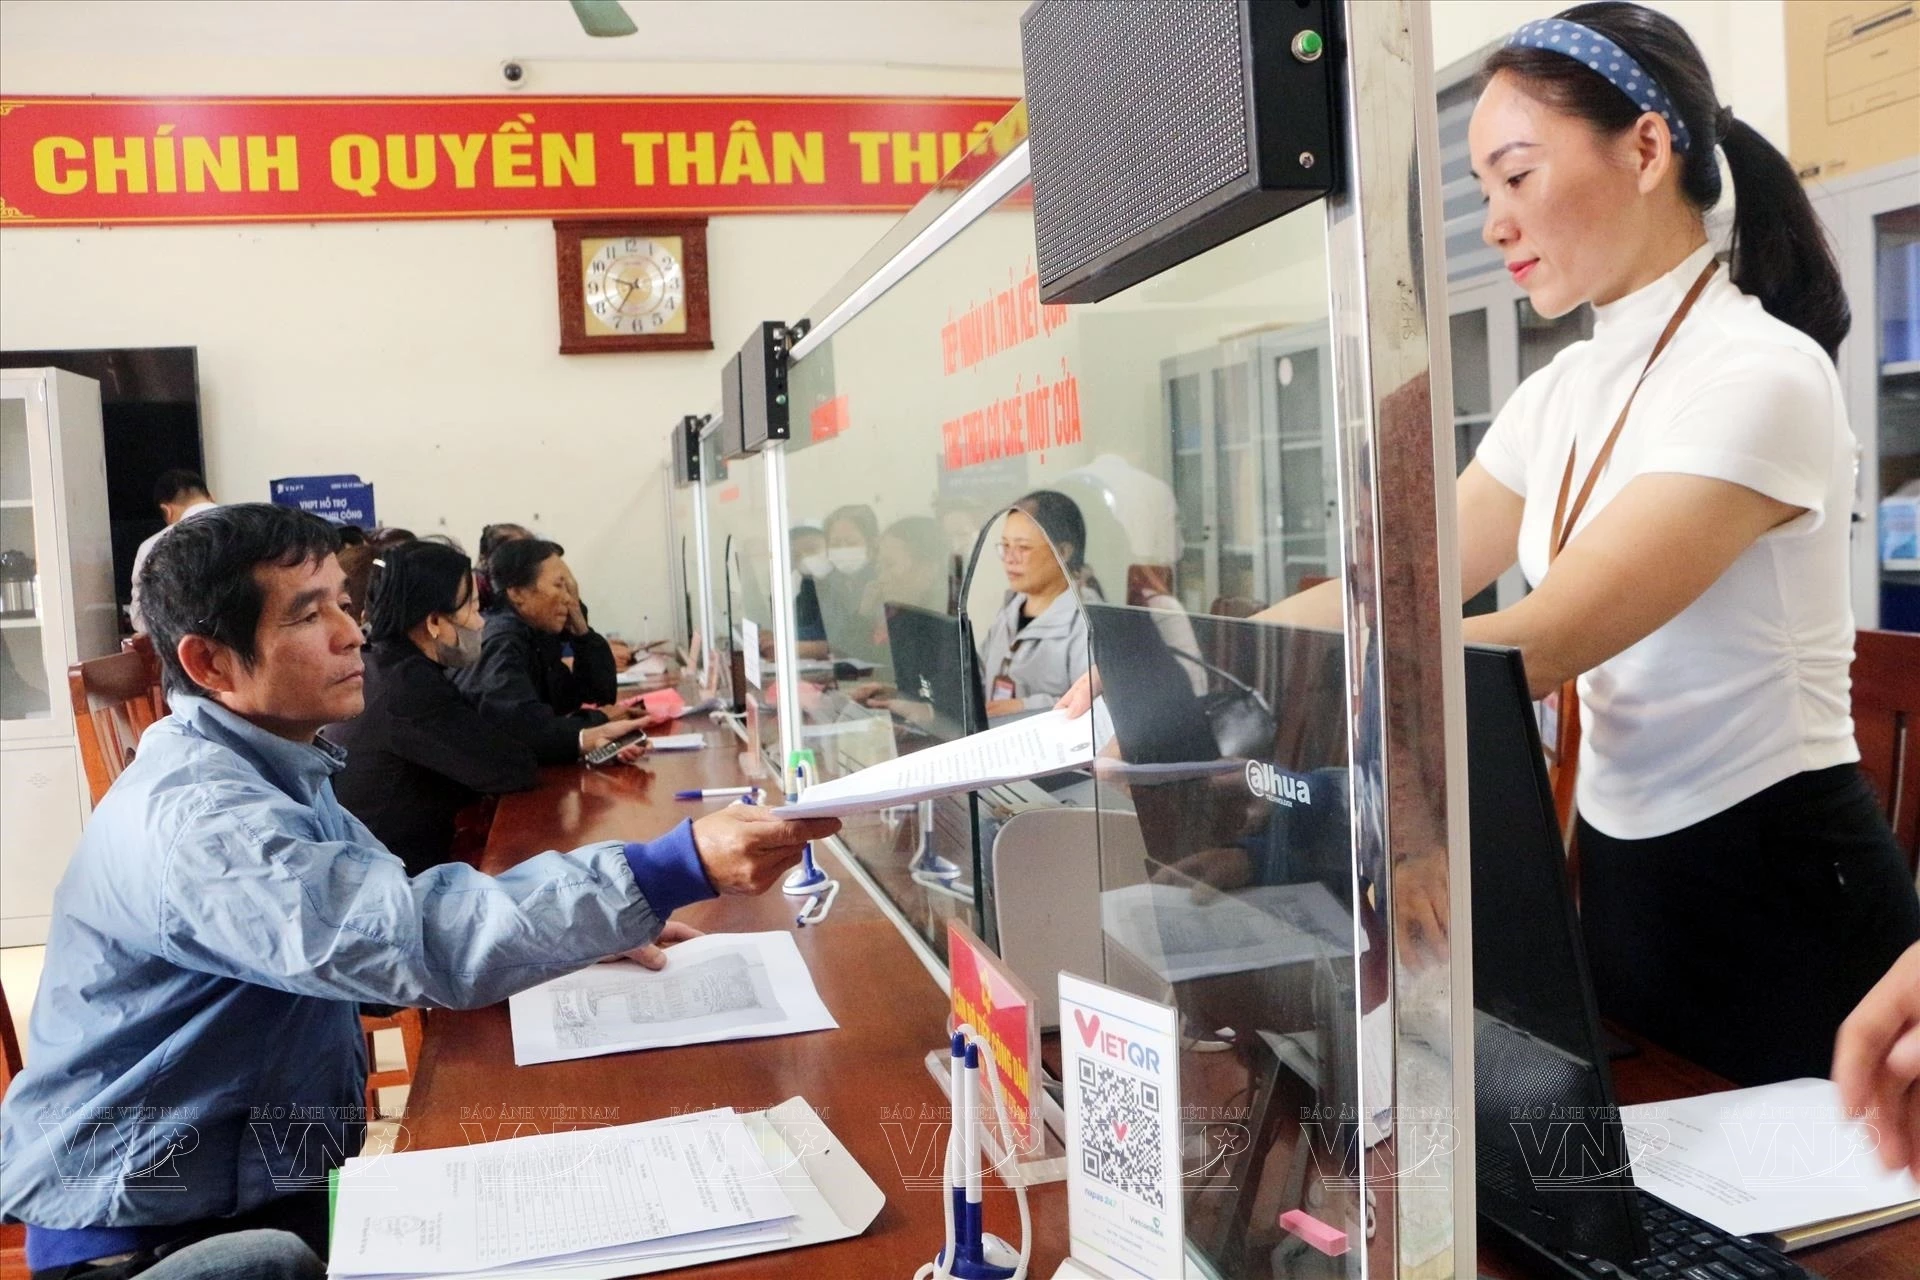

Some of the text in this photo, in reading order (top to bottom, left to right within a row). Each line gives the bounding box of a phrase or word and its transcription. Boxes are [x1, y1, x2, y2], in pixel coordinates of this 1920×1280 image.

[33, 124, 299, 195] CHÍNH
[330, 113, 597, 197] QUYỀN
[621, 120, 826, 186] THÂN
[1053, 355, 1082, 447] CỬA
